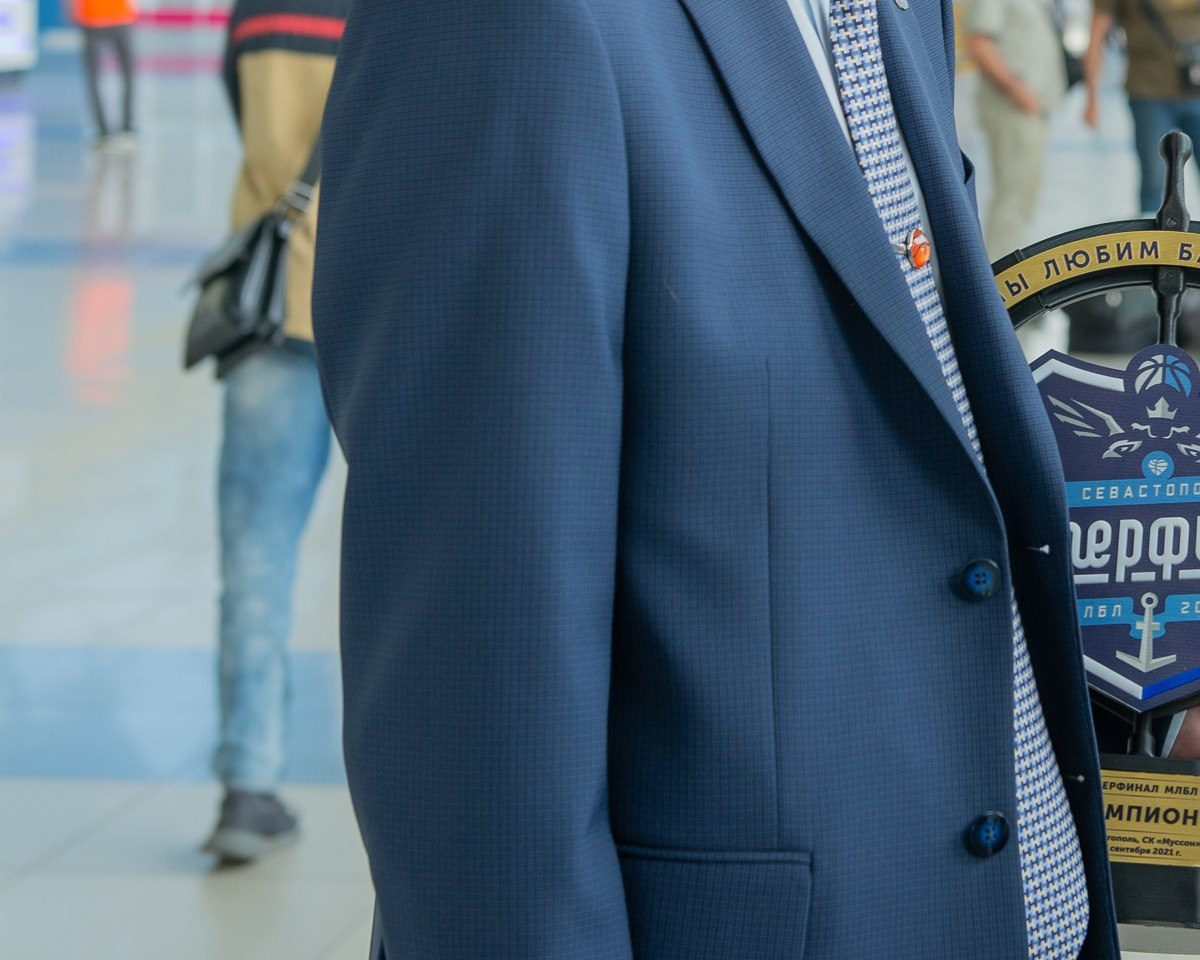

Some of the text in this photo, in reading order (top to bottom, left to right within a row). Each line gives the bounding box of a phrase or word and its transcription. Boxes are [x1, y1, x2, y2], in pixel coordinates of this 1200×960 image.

[1000, 273, 1029, 302] Ы
[1043, 241, 1160, 280] ЛЮБИМ
[1083, 604, 1122, 618] ЛБЛ
[1102, 781, 1198, 796] ЕРФИНАЛ МЛБЛ
[1105, 803, 1198, 826] МПИОН
[1107, 835, 1140, 844] тополь,
[1142, 836, 1155, 844] СК
[1110, 845, 1150, 856] сентября
[1152, 847, 1174, 856] 2021
